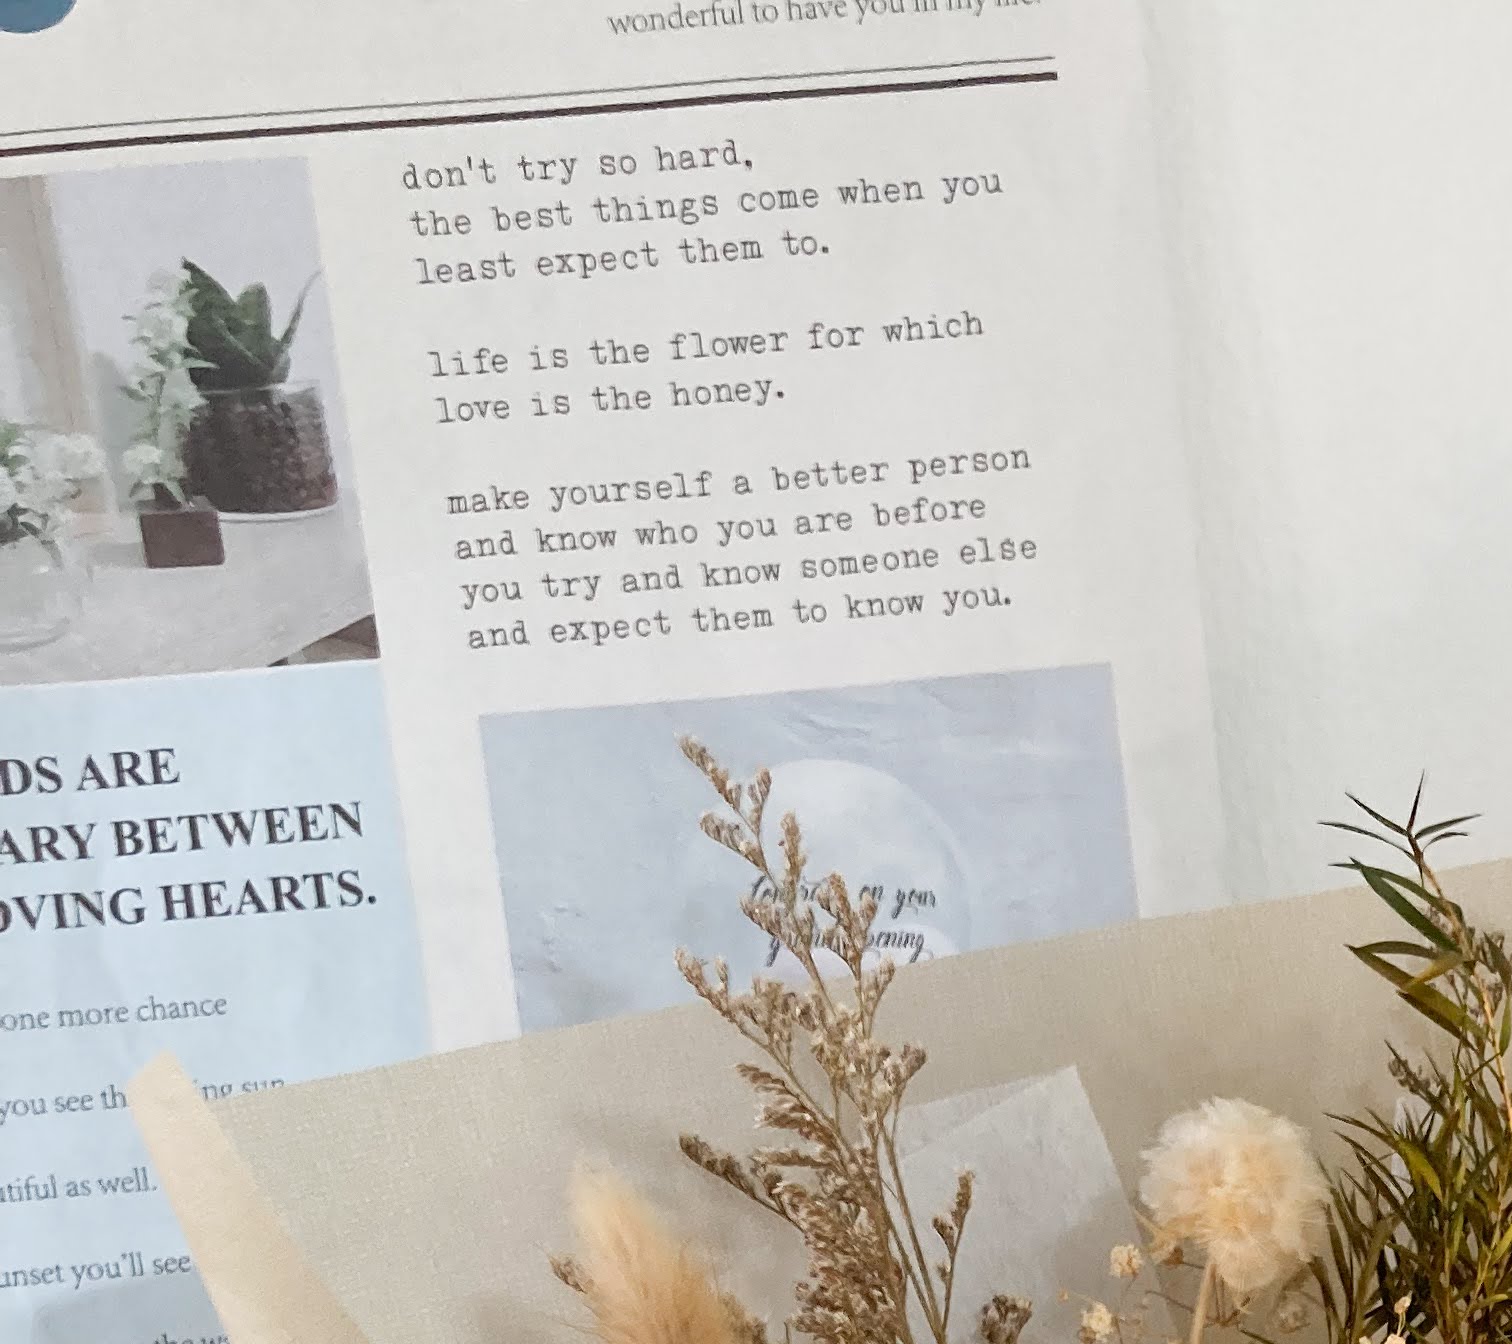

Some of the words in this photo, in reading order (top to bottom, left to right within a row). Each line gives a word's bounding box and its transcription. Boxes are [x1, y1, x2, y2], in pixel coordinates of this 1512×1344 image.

[607, 0, 745, 36] wonderful
[752, 2, 779, 22] to
[787, 0, 848, 20] have
[855, 0, 905, 25] you
[402, 155, 497, 191] don't
[517, 153, 577, 185] try
[599, 150, 638, 177] so
[654, 140, 754, 172] hard,
[409, 209, 472, 237] the
[492, 199, 572, 233] best
[592, 189, 719, 225] things
[738, 184, 819, 214] come
[837, 176, 925, 206] when
[941, 172, 1003, 203] you
[416, 252, 515, 285] least
[536, 241, 659, 279] expect
[678, 235, 764, 265] them
[782, 230, 830, 257] to.
[429, 350, 509, 378] life
[531, 343, 569, 370] is
[589, 338, 650, 367] the
[670, 328, 789, 360] flower
[808, 321, 864, 351] for
[882, 310, 984, 343] which
[435, 396, 510, 424] love
[532, 391, 570, 417] is
[591, 385, 652, 414] the
[670, 377, 786, 408] honey.
[447, 487, 530, 515] make
[550, 471, 713, 513] yourself
[733, 476, 753, 494] a
[771, 460, 889, 492] better
[908, 446, 1030, 485] person
[455, 530, 519, 560] and
[536, 522, 618, 553] know
[635, 521, 699, 546] who
[717, 517, 778, 547] you
[795, 511, 853, 537] are
[874, 496, 986, 528] before
[461, 580, 523, 610] you
[541, 571, 601, 601] try
[622, 564, 681, 593] and
[700, 557, 781, 589] know
[800, 546, 940, 580] someone
[960, 537, 1038, 565] else
[468, 620, 530, 650] and
[550, 610, 672, 646] expect
[692, 605, 773, 634] them
[792, 600, 828, 624] to
[847, 591, 924, 620] know
[942, 585, 1011, 616] you.
[77, 748, 180, 791] ARE
[112, 800, 364, 857] BETWEEN
[160, 870, 377, 922] HEARTS.
[0, 1008, 50, 1031] one
[58, 1007, 129, 1028] more
[136, 993, 228, 1024] chance
[54, 1093, 94, 1113] see
[101, 1084, 128, 1110] th
[65, 1178, 91, 1197] as
[97, 1166, 158, 1193] well.
[71, 1250, 145, 1289] you'll
[152, 1255, 191, 1276] see
